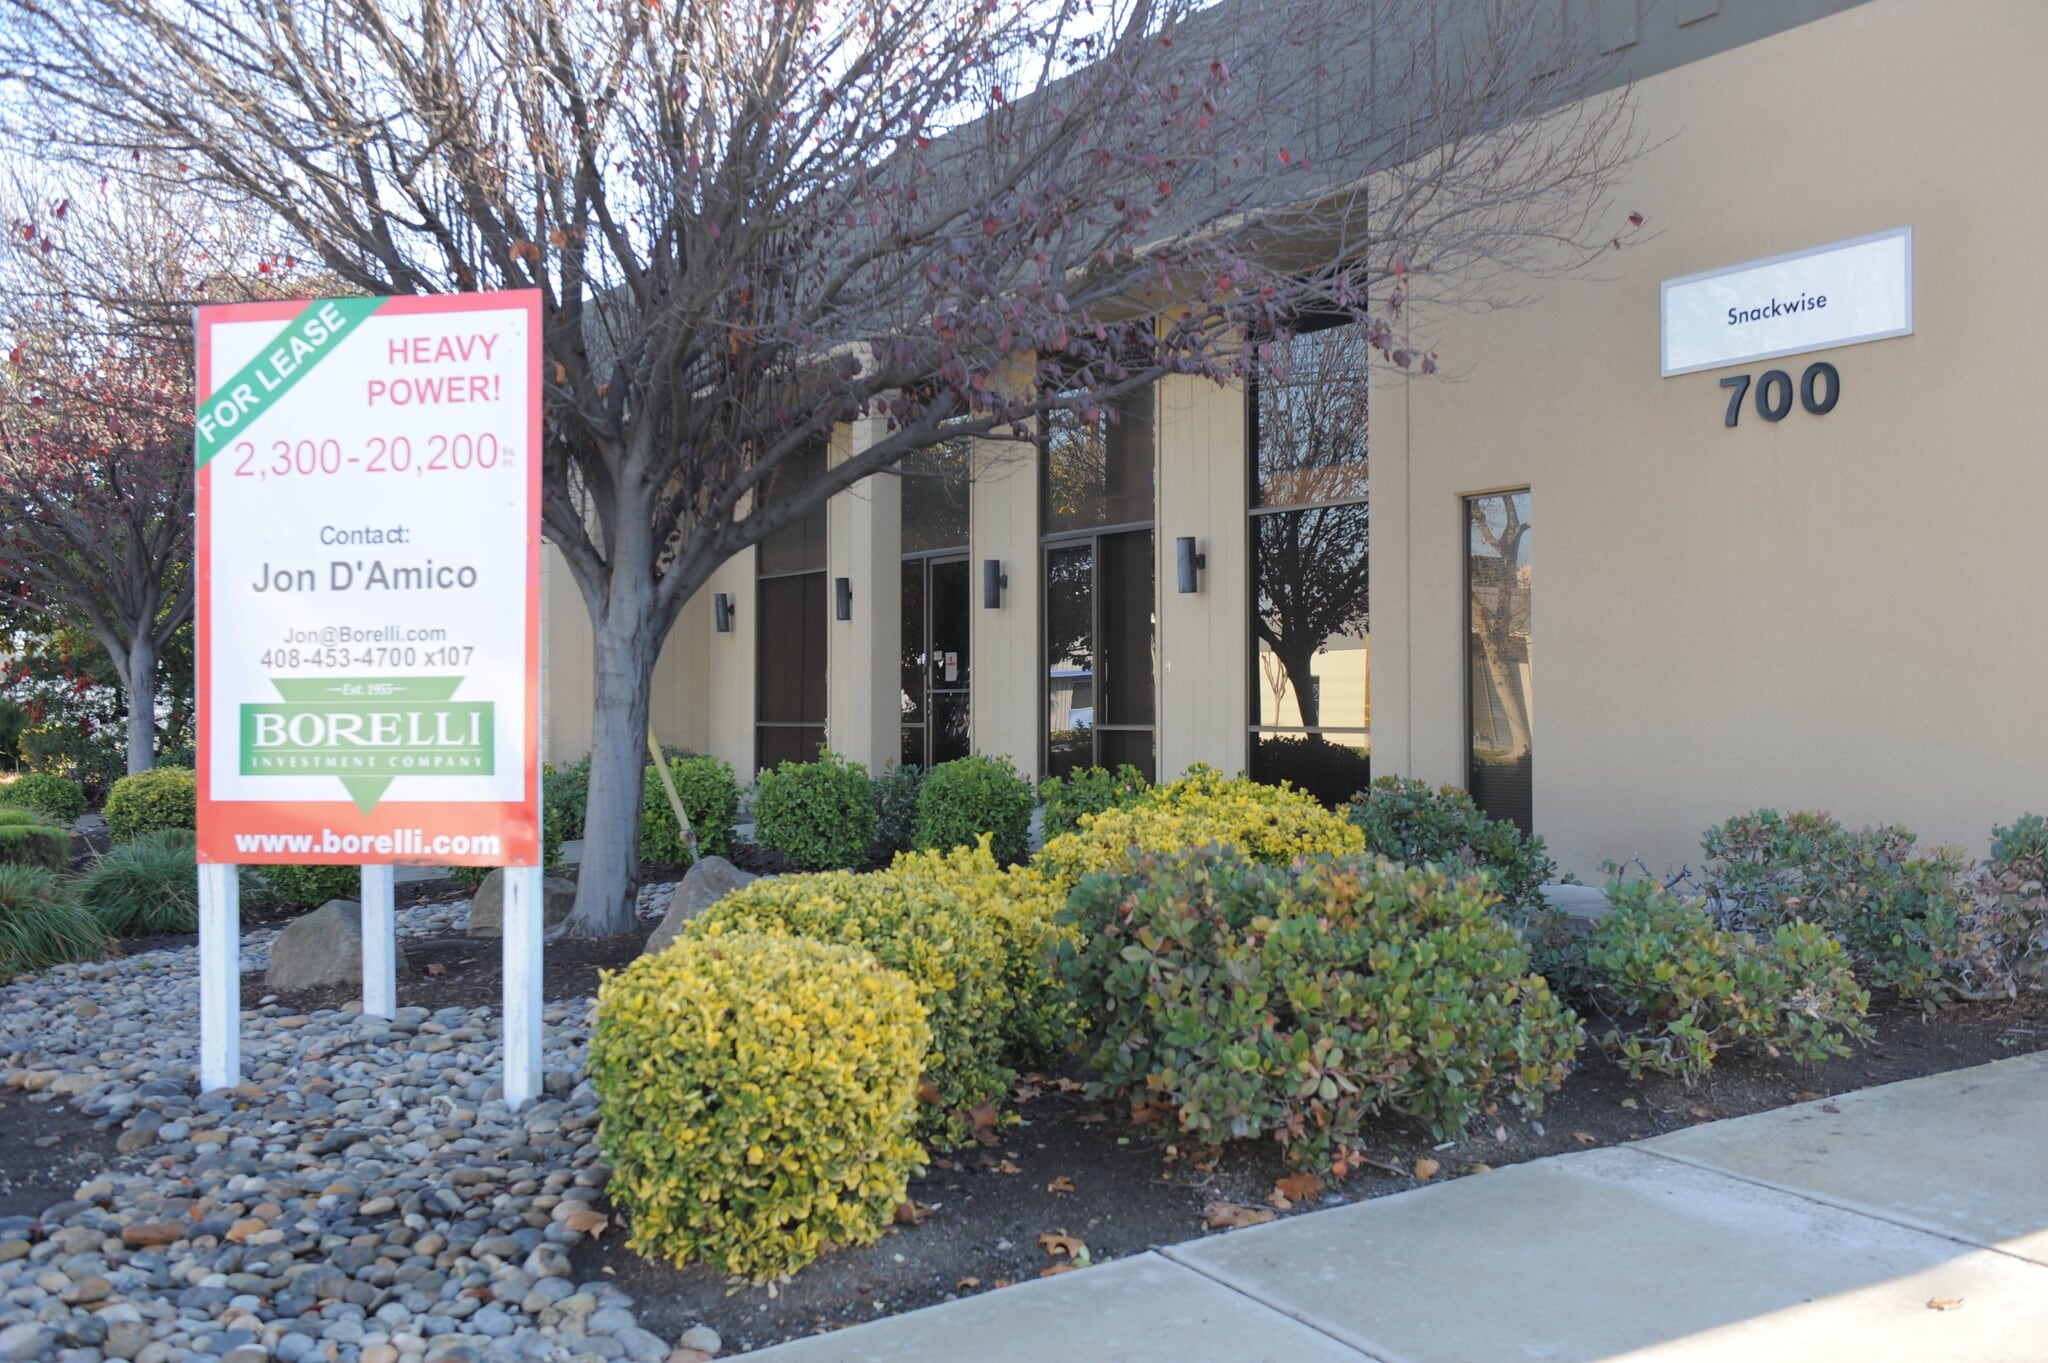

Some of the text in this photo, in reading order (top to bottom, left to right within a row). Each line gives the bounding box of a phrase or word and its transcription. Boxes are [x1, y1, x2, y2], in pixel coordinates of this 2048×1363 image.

[1727, 292, 1828, 326] Snackwise
[388, 334, 499, 365] HEAVY
[197, 301, 348, 444] FOR LEASE
[368, 375, 501, 407] POWER!
[1719, 361, 1841, 428] 700
[233, 432, 498, 482] 2,300-20,200
[320, 525, 410, 546] Contact:
[252, 558, 478, 593] Jon D'Amico
[283, 625, 447, 647] Jon@Borelli.com
[260, 646, 475, 668] 408-453-4700 x107
[252, 711, 482, 747] BORELLI
[252, 755, 484, 768] INVESTMENT COMPANY
[234, 829, 501, 856] www.borelli.com
